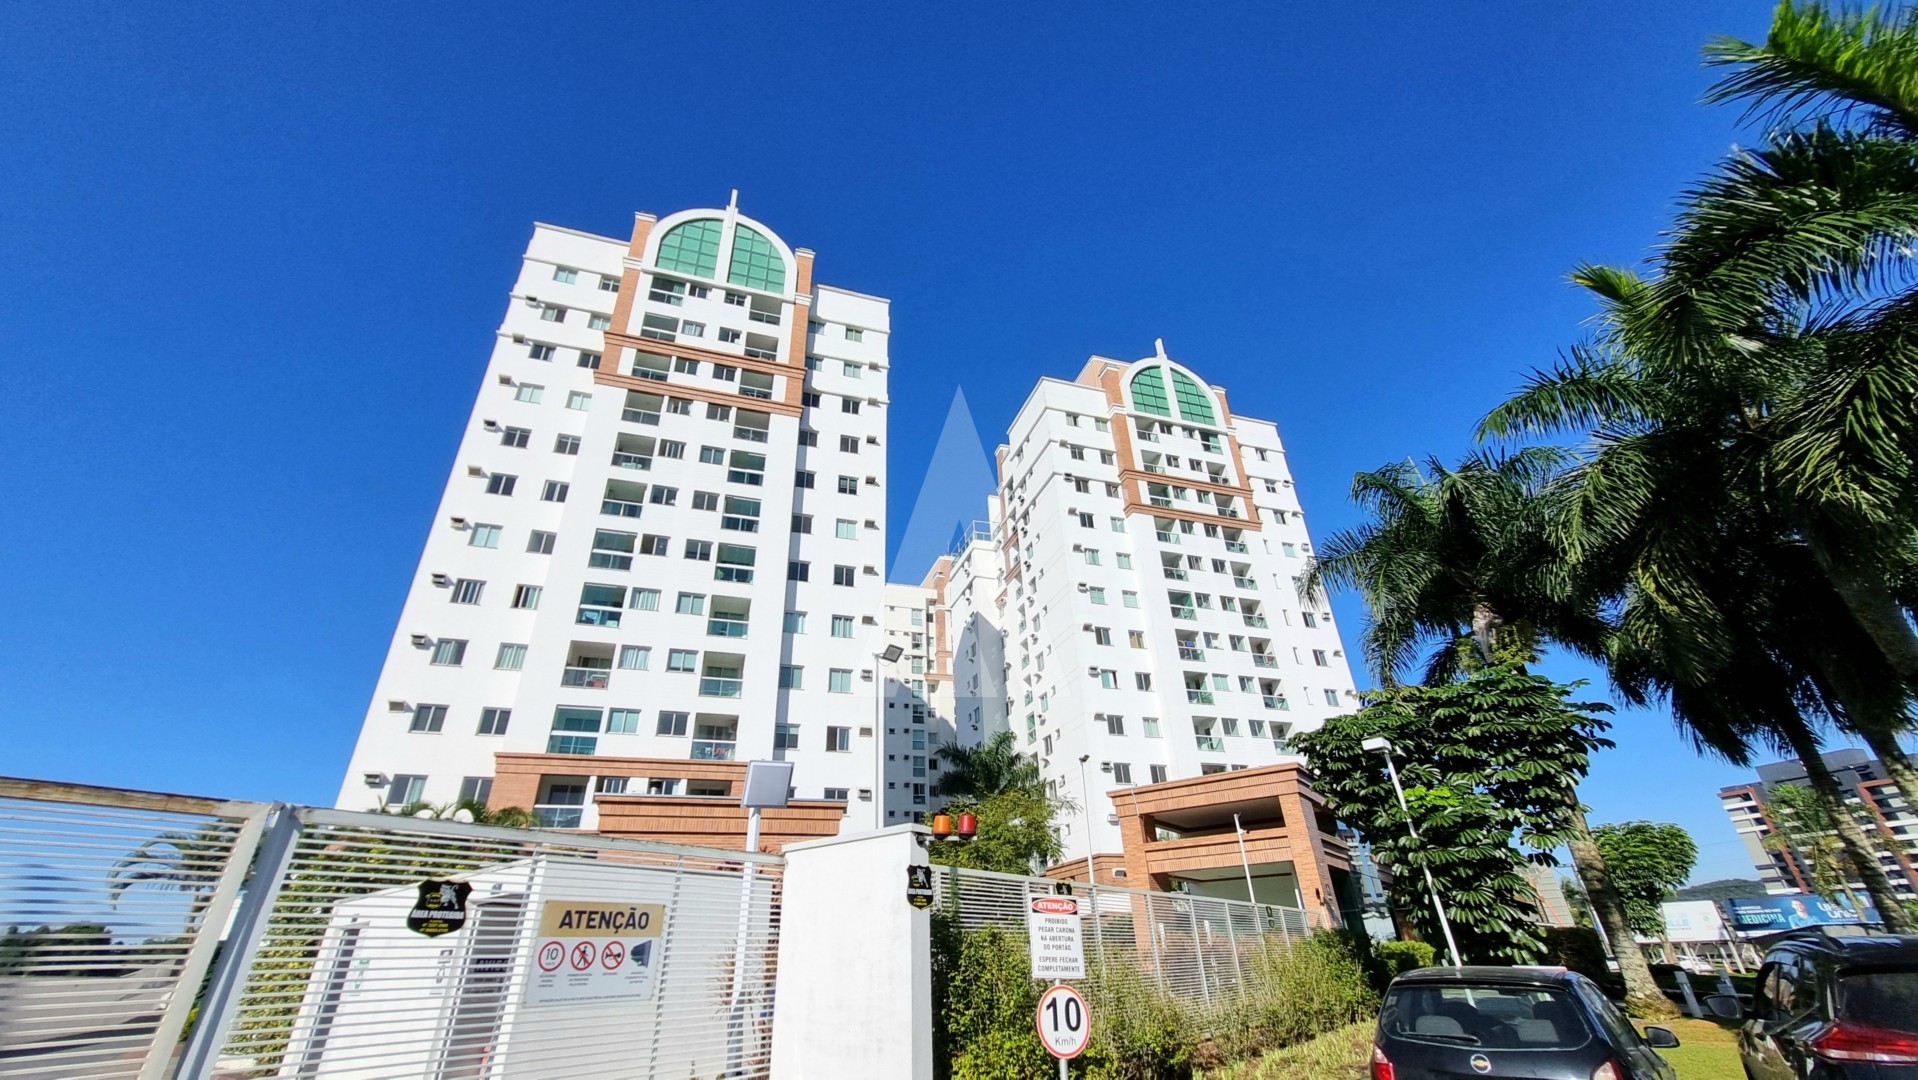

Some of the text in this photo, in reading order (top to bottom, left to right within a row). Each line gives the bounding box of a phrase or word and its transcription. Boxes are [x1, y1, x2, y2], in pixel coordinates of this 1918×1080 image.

[1037, 901, 1074, 911] ATENÇÃO
[558, 907, 650, 934] ATENÇÃO
[1044, 917, 1068, 925] PROIBIDO
[545, 948, 559, 960] 10
[1045, 997, 1082, 1032] 10
[1055, 1037, 1077, 1047] Km/h
